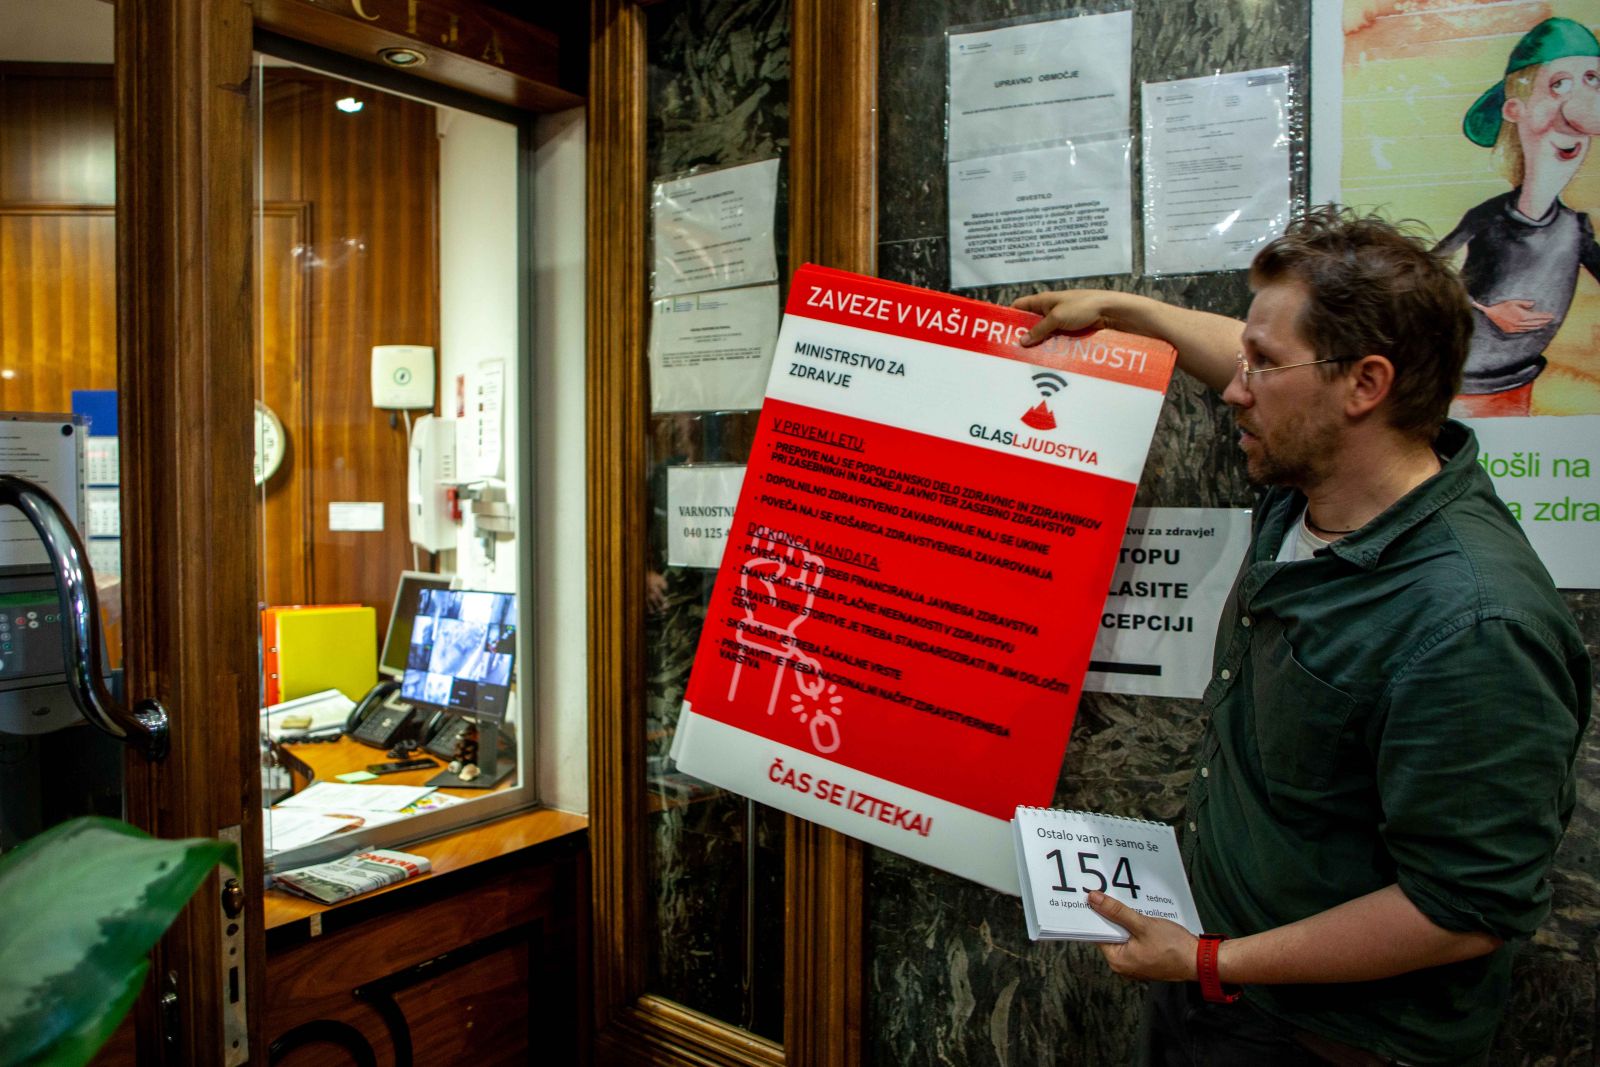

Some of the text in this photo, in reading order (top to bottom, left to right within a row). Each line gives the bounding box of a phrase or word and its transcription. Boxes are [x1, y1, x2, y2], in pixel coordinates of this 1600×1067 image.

[994, 69, 1079, 88] UPRAVNO OBMOČJE
[807, 286, 892, 319] ZAVEZE
[894, 303, 911, 323] V
[912, 302, 969, 335] VAŠI
[795, 341, 906, 375] MINISTRSTVO ZA
[789, 363, 851, 387] ZDRAVJE
[783, 421, 827, 440] PRVEM
[1553, 459, 1590, 478] na
[771, 452, 1075, 536] PRI ZASEBNIKIH IN RAZMEJI JAVNO TER ZASEBNO ZDRAVSTVO
[775, 441, 1101, 531] PREPOVE NAJ SE POPOLDANSKO DELO ZDRAVNIC IN ZDRAVNIKOV
[766, 473, 1050, 555] DOPOLNILNO ZDRAVSTVENO ZAVAROVANJE NAJ SE UKINE
[1534, 496, 1600, 521] zdra
[683, 528, 702, 538] 040
[705, 528, 722, 538] 125
[761, 493, 1054, 580] POVEČA NAJ SE KOŠARICA ZDRAVSTVENEGA ZAVAROVANJA
[767, 527, 812, 550] KONCA
[1148, 528, 1162, 536] za
[1165, 527, 1215, 538] zdravje!
[1119, 548, 1180, 565] TOPU
[782, 555, 800, 567] NAJ
[803, 561, 814, 571] SE
[817, 565, 849, 581] OBSEG
[851, 575, 924, 603] FINANCIRANJA
[927, 596, 975, 617] JAVNEGA
[976, 610, 1039, 635] ZDRAVSTVA
[1101, 613, 1194, 632] CEPCIJI
[767, 757, 933, 837] ČAS SE IZTEKA!
[1037, 828, 1159, 853] Ostalo vam je samo še
[1046, 849, 1141, 899] 154
[1050, 899, 1060, 907] da
